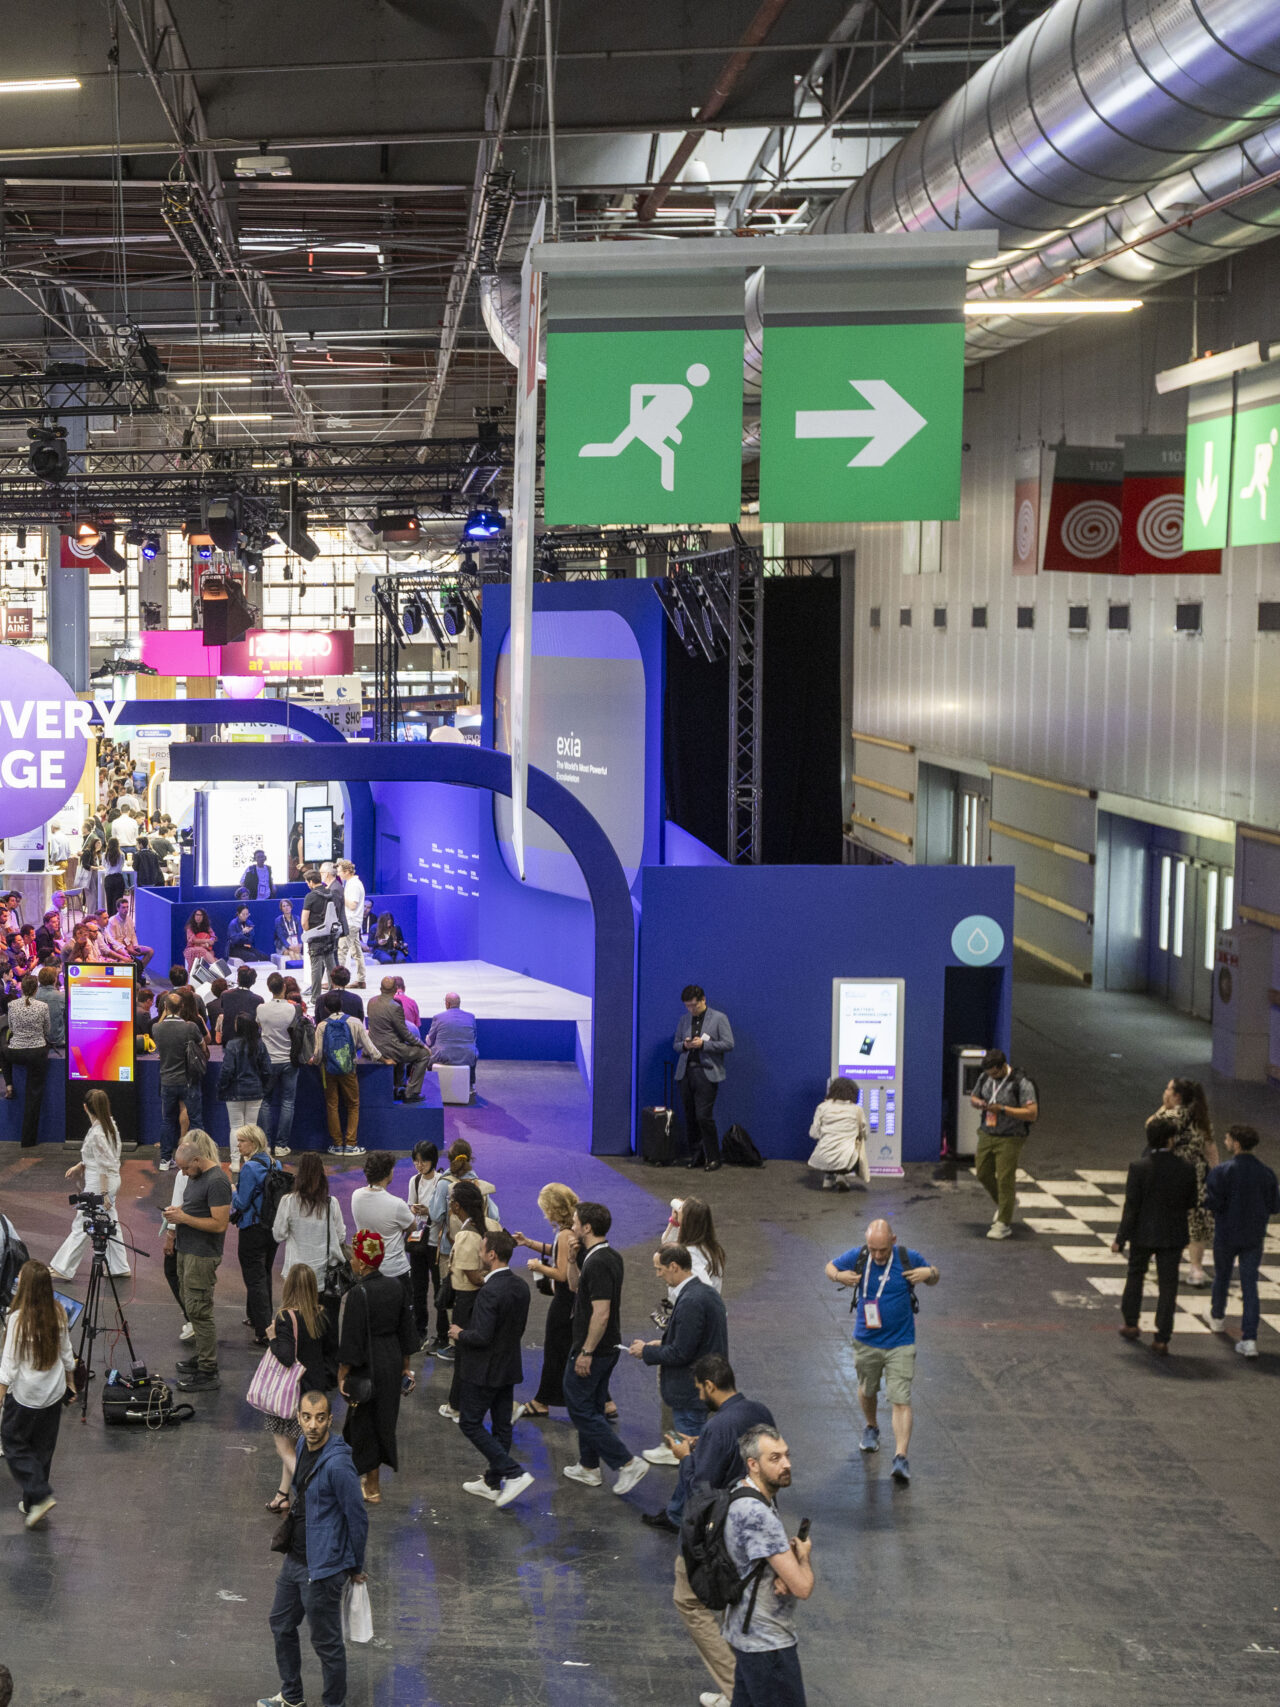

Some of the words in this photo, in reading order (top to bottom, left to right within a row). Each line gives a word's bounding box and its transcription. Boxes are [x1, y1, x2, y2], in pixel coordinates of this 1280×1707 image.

[1161, 451, 1187, 463] 110
[1089, 462, 1114, 472] 1107
[556, 731, 581, 758] exia
